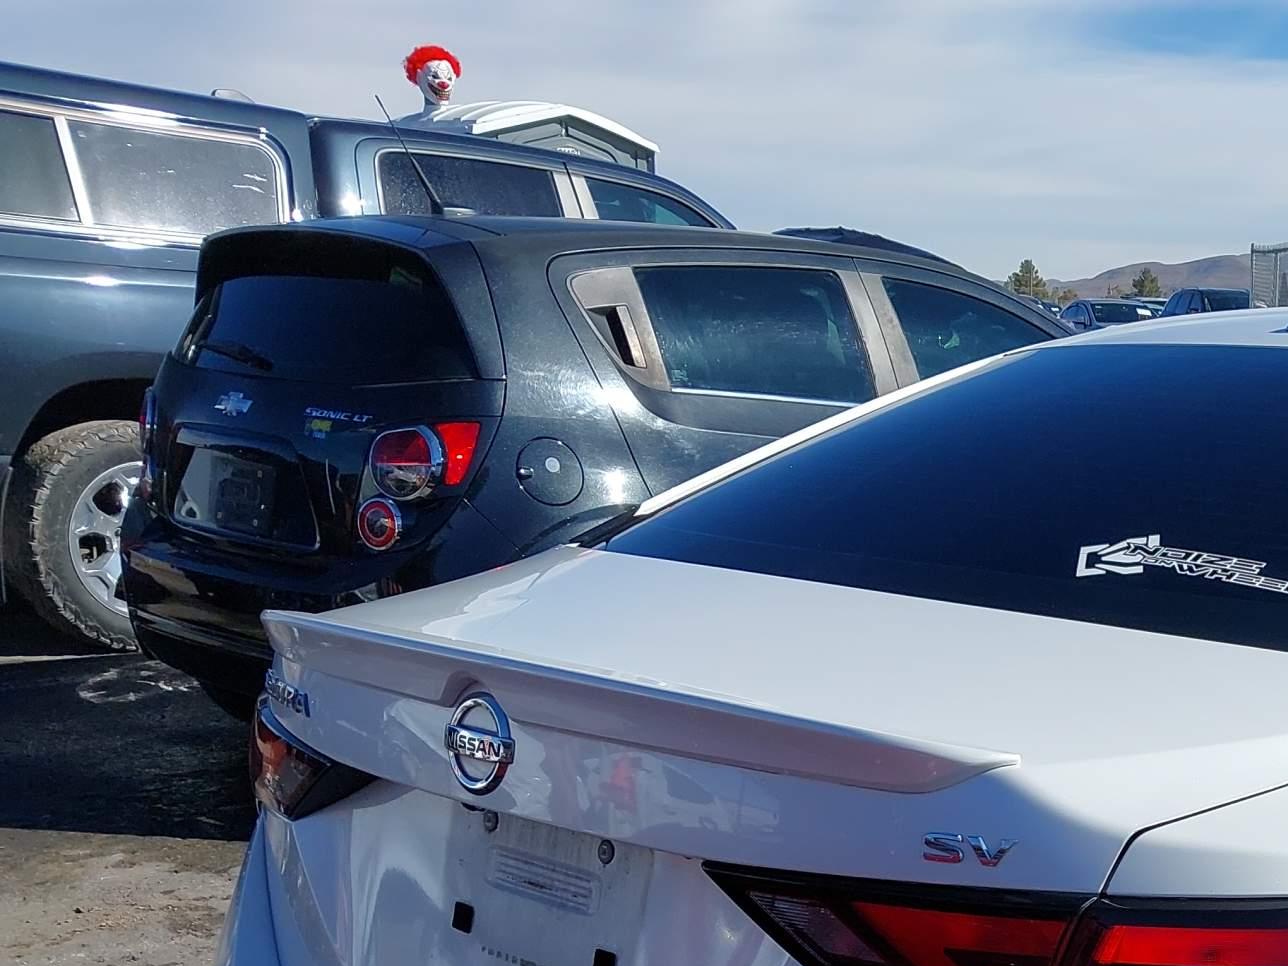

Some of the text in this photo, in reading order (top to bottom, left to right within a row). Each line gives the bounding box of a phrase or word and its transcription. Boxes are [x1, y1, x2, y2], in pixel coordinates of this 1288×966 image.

[304, 407, 374, 423] SONIC LT
[1125, 541, 1267, 575] NOIZE
[447, 726, 502, 759] NISSAN
[922, 831, 1019, 867] SV
